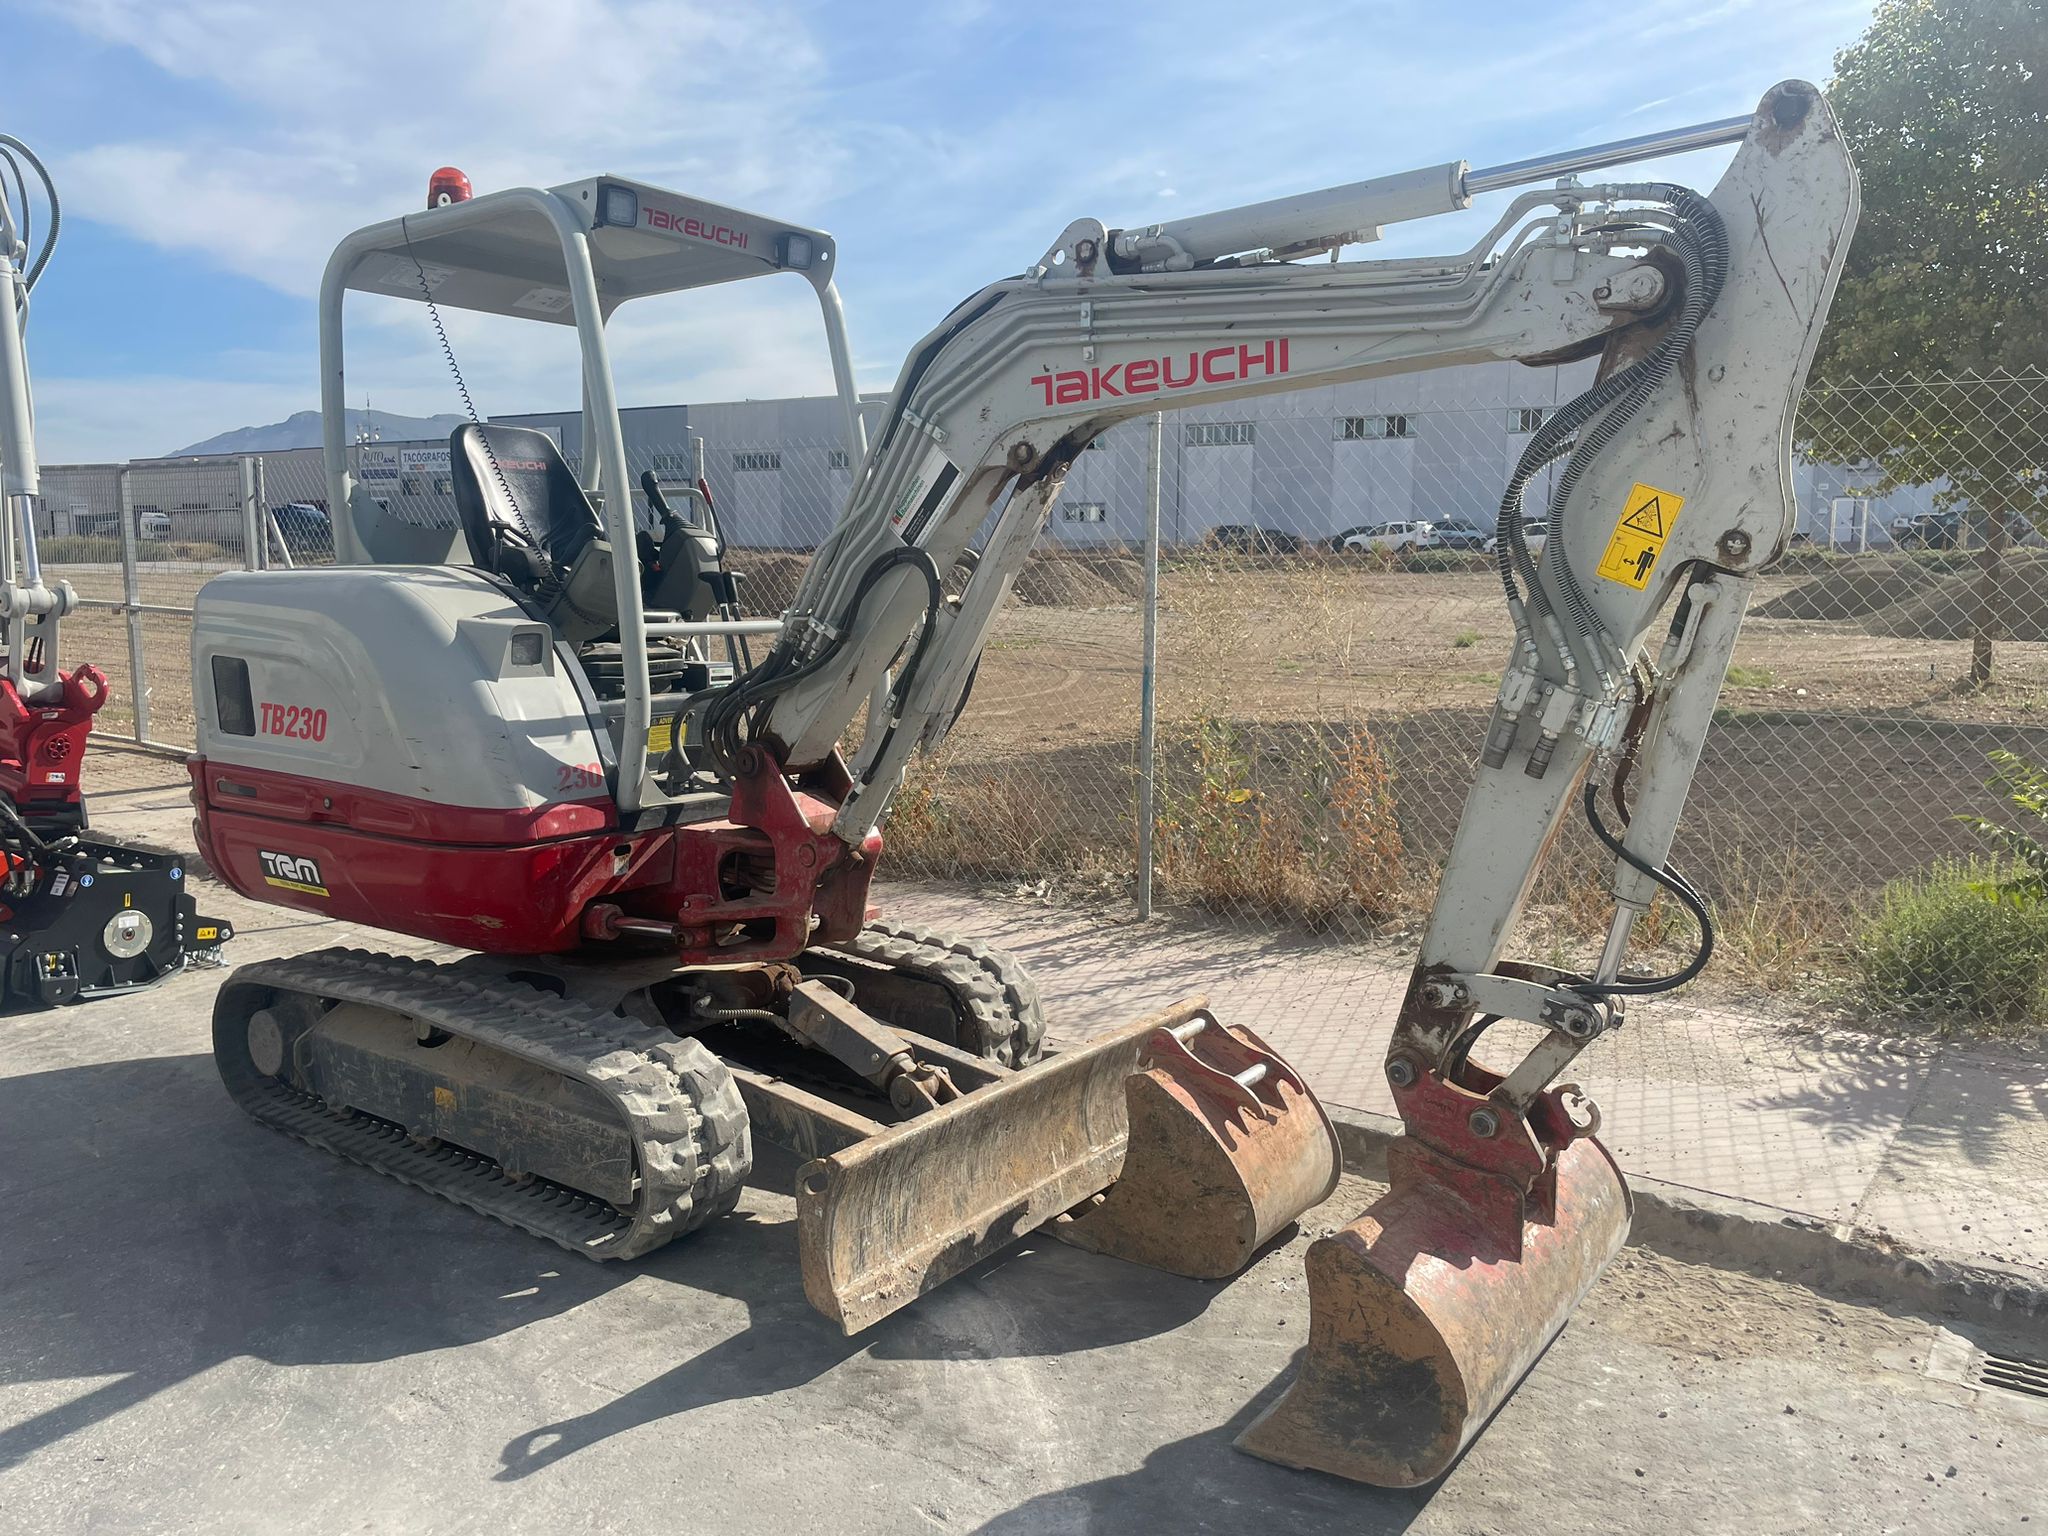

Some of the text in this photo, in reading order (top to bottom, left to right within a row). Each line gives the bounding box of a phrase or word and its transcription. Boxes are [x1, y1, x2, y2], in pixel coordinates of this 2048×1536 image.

[642, 206, 749, 250] TAKEUCHI
[1030, 337, 1290, 407] TAKEUCHI
[403, 450, 451, 463] TACÓGRAFOS
[260, 702, 328, 743] TB230
[555, 762, 603, 791] 230
[260, 850, 321, 885] TRM
